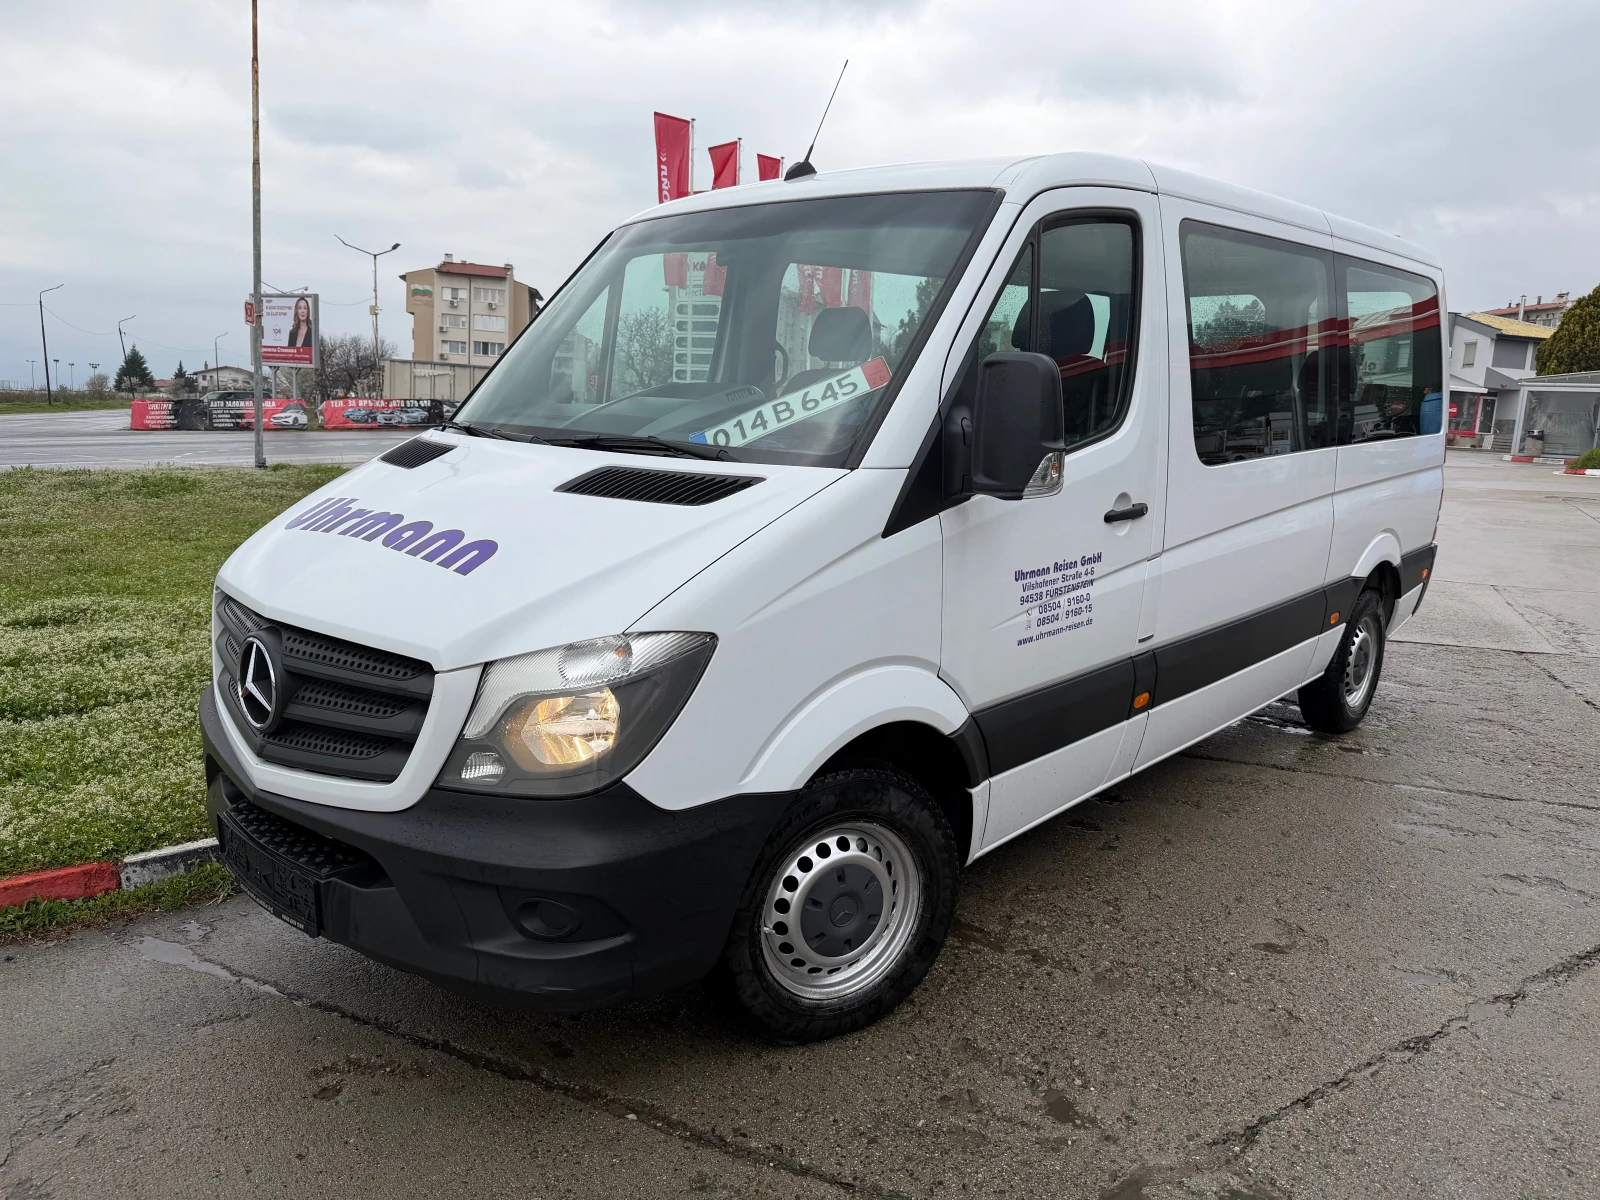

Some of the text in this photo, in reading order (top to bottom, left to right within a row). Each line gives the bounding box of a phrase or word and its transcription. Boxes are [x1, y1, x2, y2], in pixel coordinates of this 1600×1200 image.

[348, 399, 357, 407] ЗА
[284, 498, 499, 576] Uhrmann
[1014, 552, 1102, 582] Uhrmann Reisen GmbH
[1022, 567, 1095, 592] Vilshofener Straße 4-6
[1020, 592, 1044, 606] 94538
[1038, 600, 1061, 614] 08504
[1067, 592, 1091, 607] 9160-0
[1036, 613, 1060, 627] 08504
[1065, 604, 1093, 619] 9160-15
[1017, 617, 1093, 646] www.uhrmann-reisen.de
